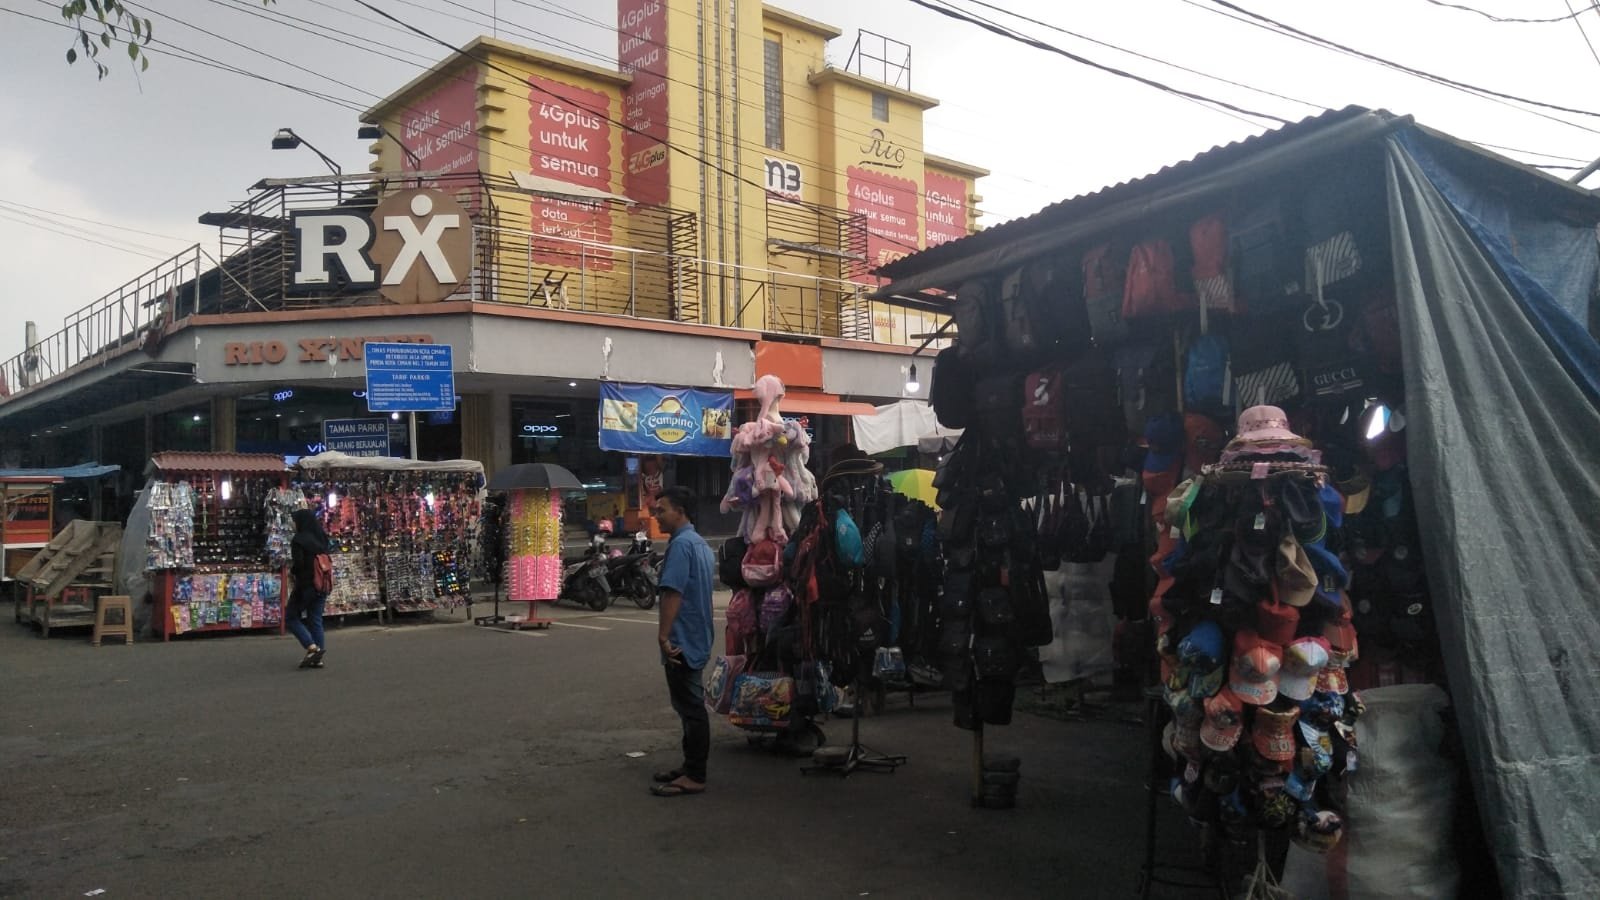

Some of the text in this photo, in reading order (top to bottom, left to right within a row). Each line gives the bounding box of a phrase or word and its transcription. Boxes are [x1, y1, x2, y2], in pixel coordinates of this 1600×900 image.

[621, 0, 660, 29] 4Gplus
[622, 25, 652, 54] untuk
[622, 48, 658, 74] semua
[635, 82, 665, 105] jaringan
[406, 109, 440, 139] 4Gplus
[539, 101, 600, 130] 4Gplus
[406, 120, 471, 167] untuk semua
[540, 130, 589, 152] untuk
[860, 128, 904, 162] Rio
[540, 155, 599, 177] semua
[854, 184, 895, 207] 4Gplus
[926, 190, 961, 210] 4Gplus
[542, 208, 568, 221] data
[880, 213, 906, 226] semua
[926, 210, 954, 225] untuk
[224, 340, 288, 366] RIO
[1314, 368, 1356, 385] GUCCI
[328, 423, 385, 433] TAMAN PARKIR
[648, 416, 693, 428] Campina
[328, 440, 387, 450] DILARANG BERJUALAN
